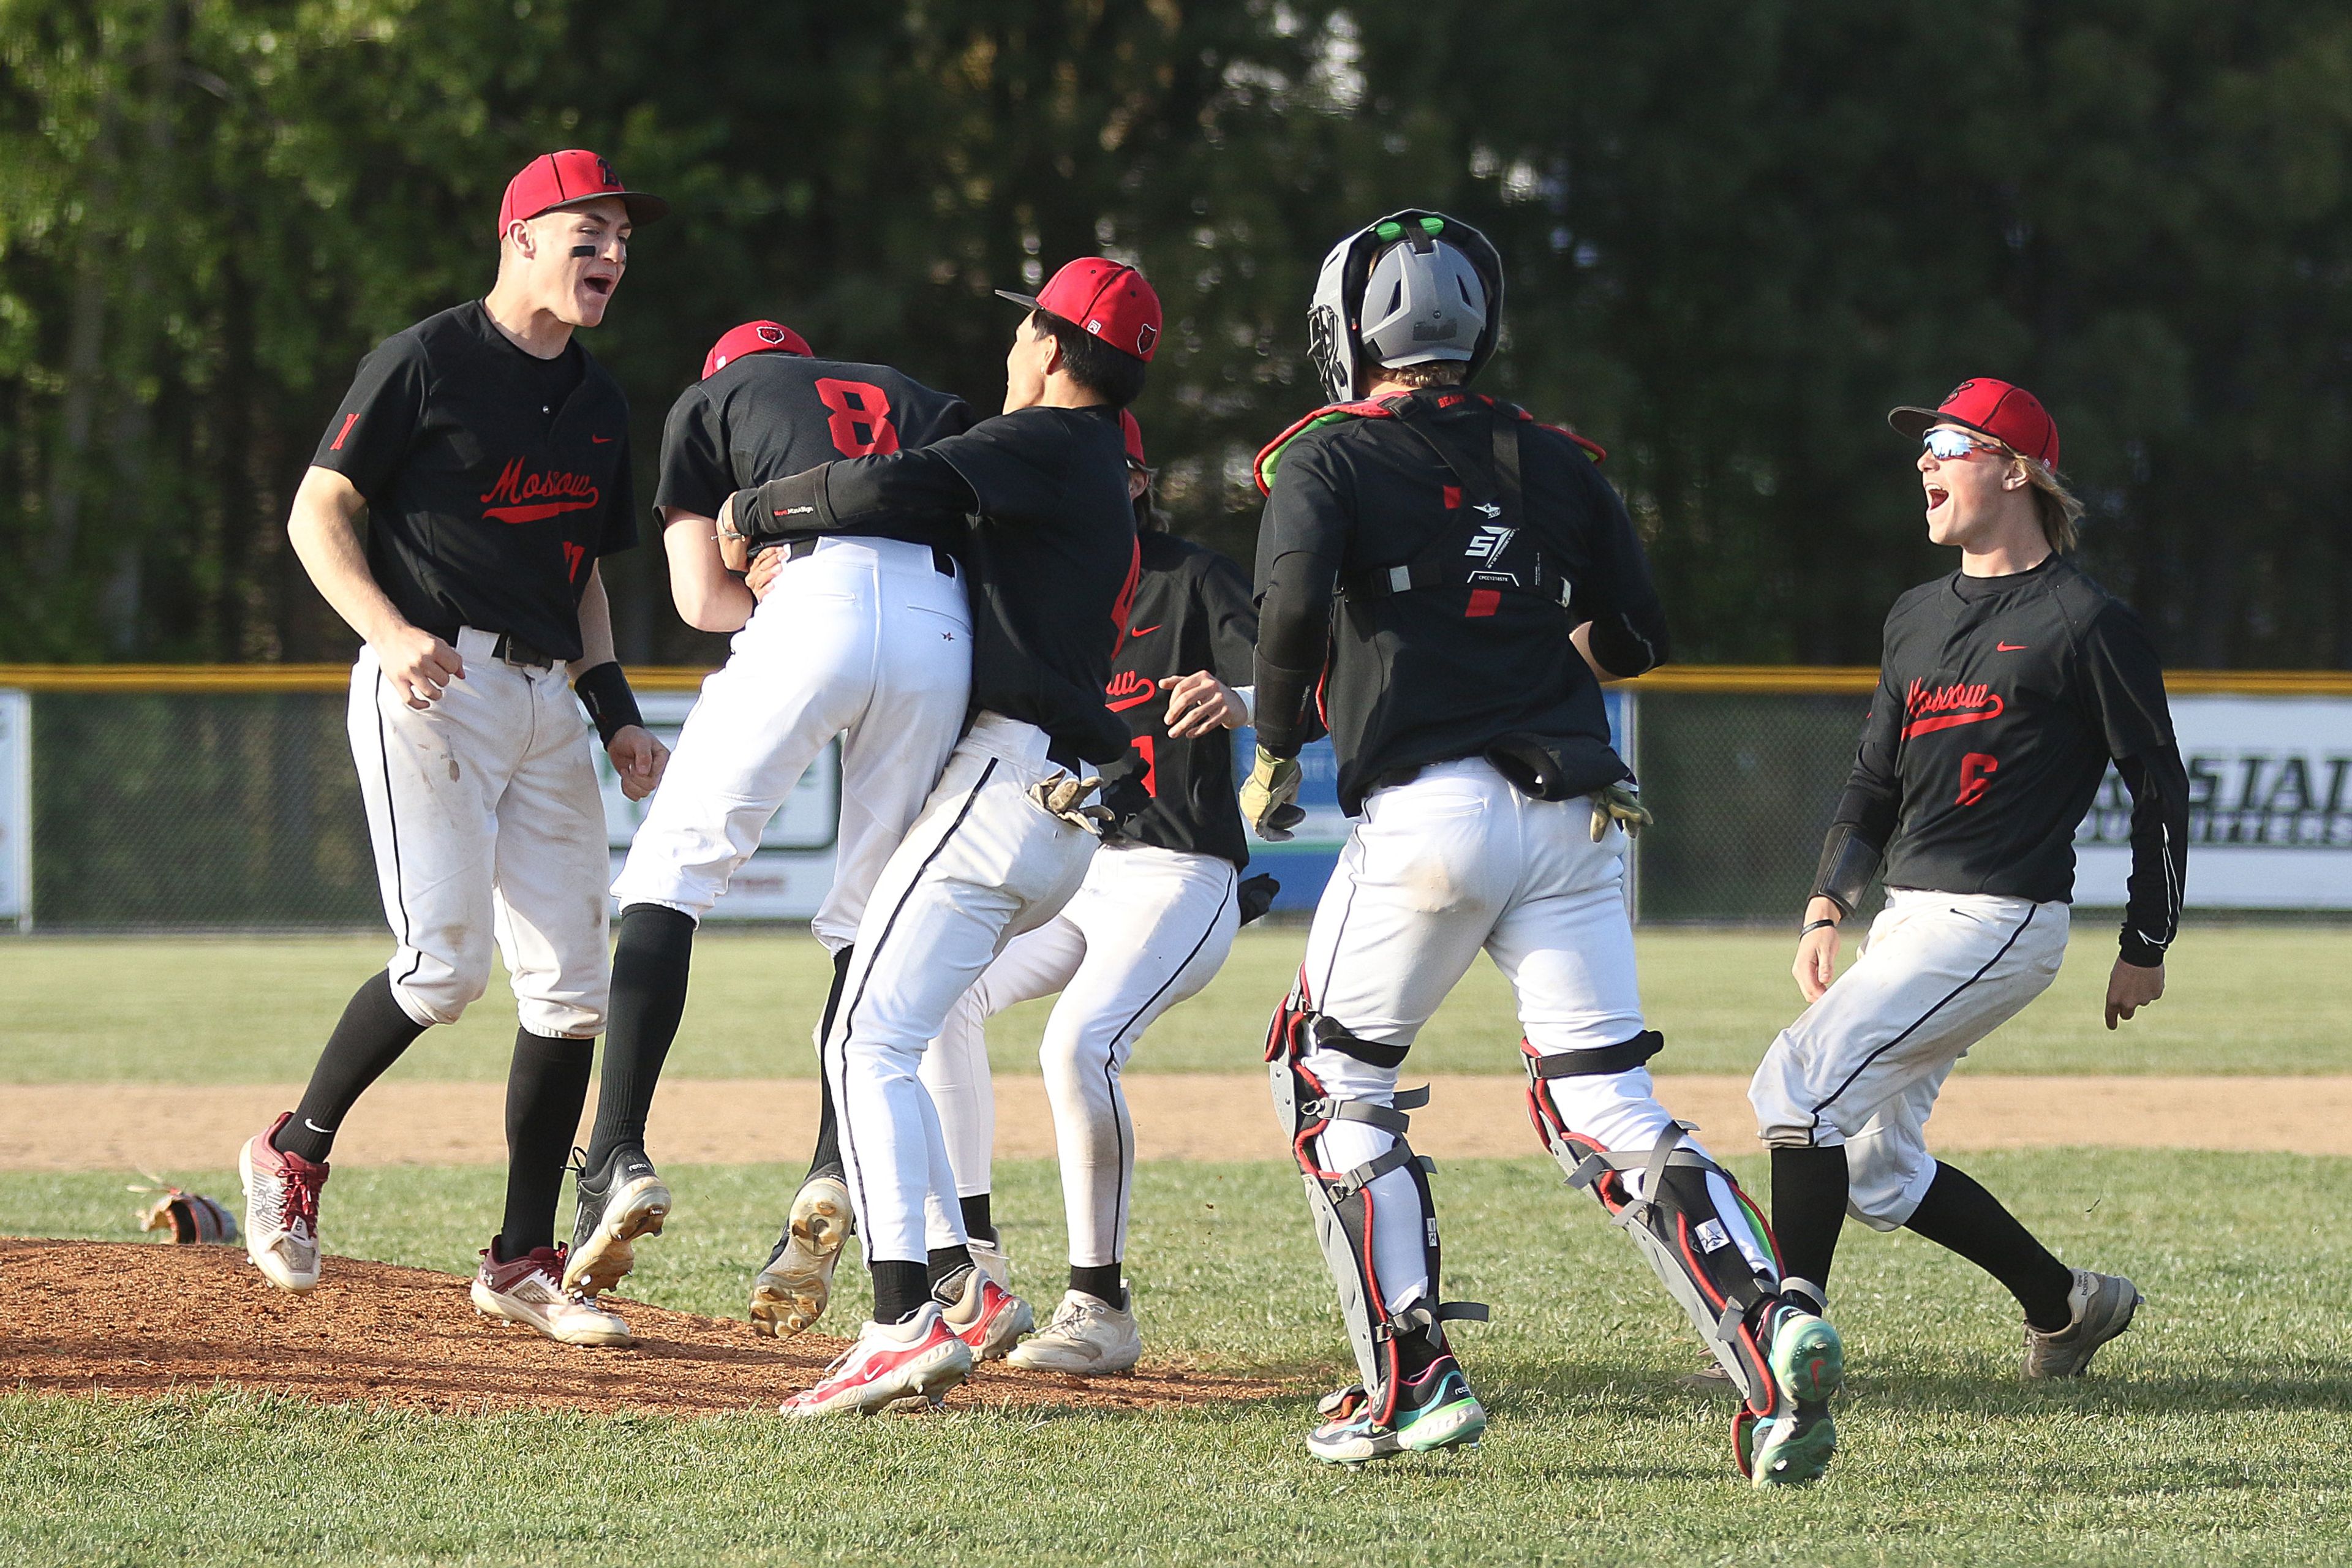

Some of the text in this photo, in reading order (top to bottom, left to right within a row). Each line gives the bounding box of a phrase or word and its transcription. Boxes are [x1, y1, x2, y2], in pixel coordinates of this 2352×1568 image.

[815, 377, 900, 459] 8
[480, 456, 594, 503] Moscow
[1955, 753, 1999, 806] 6
